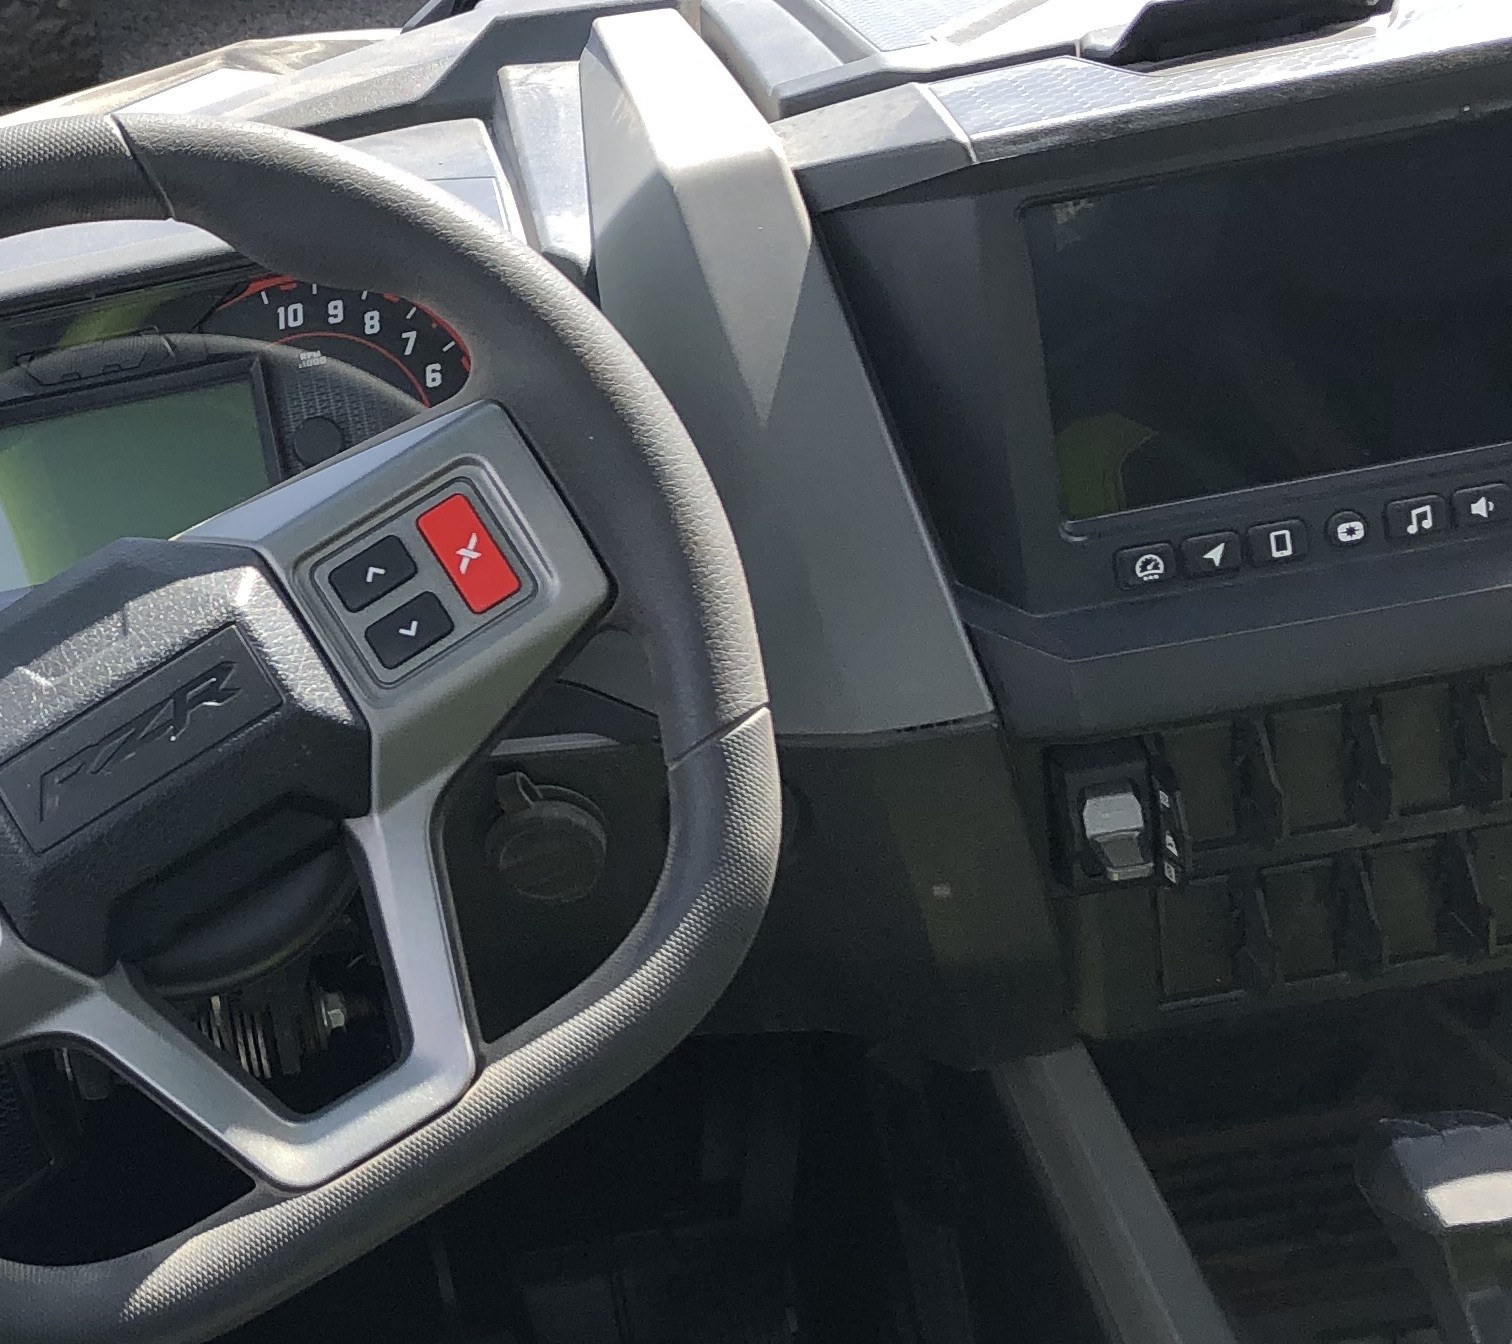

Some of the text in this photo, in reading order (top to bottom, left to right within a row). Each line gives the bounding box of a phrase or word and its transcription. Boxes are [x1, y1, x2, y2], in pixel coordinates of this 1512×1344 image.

[276, 303, 304, 330] 10
[327, 299, 344, 325] 9
[363, 310, 381, 335] 8
[401, 330, 417, 356] 7
[425, 363, 442, 388] 6
